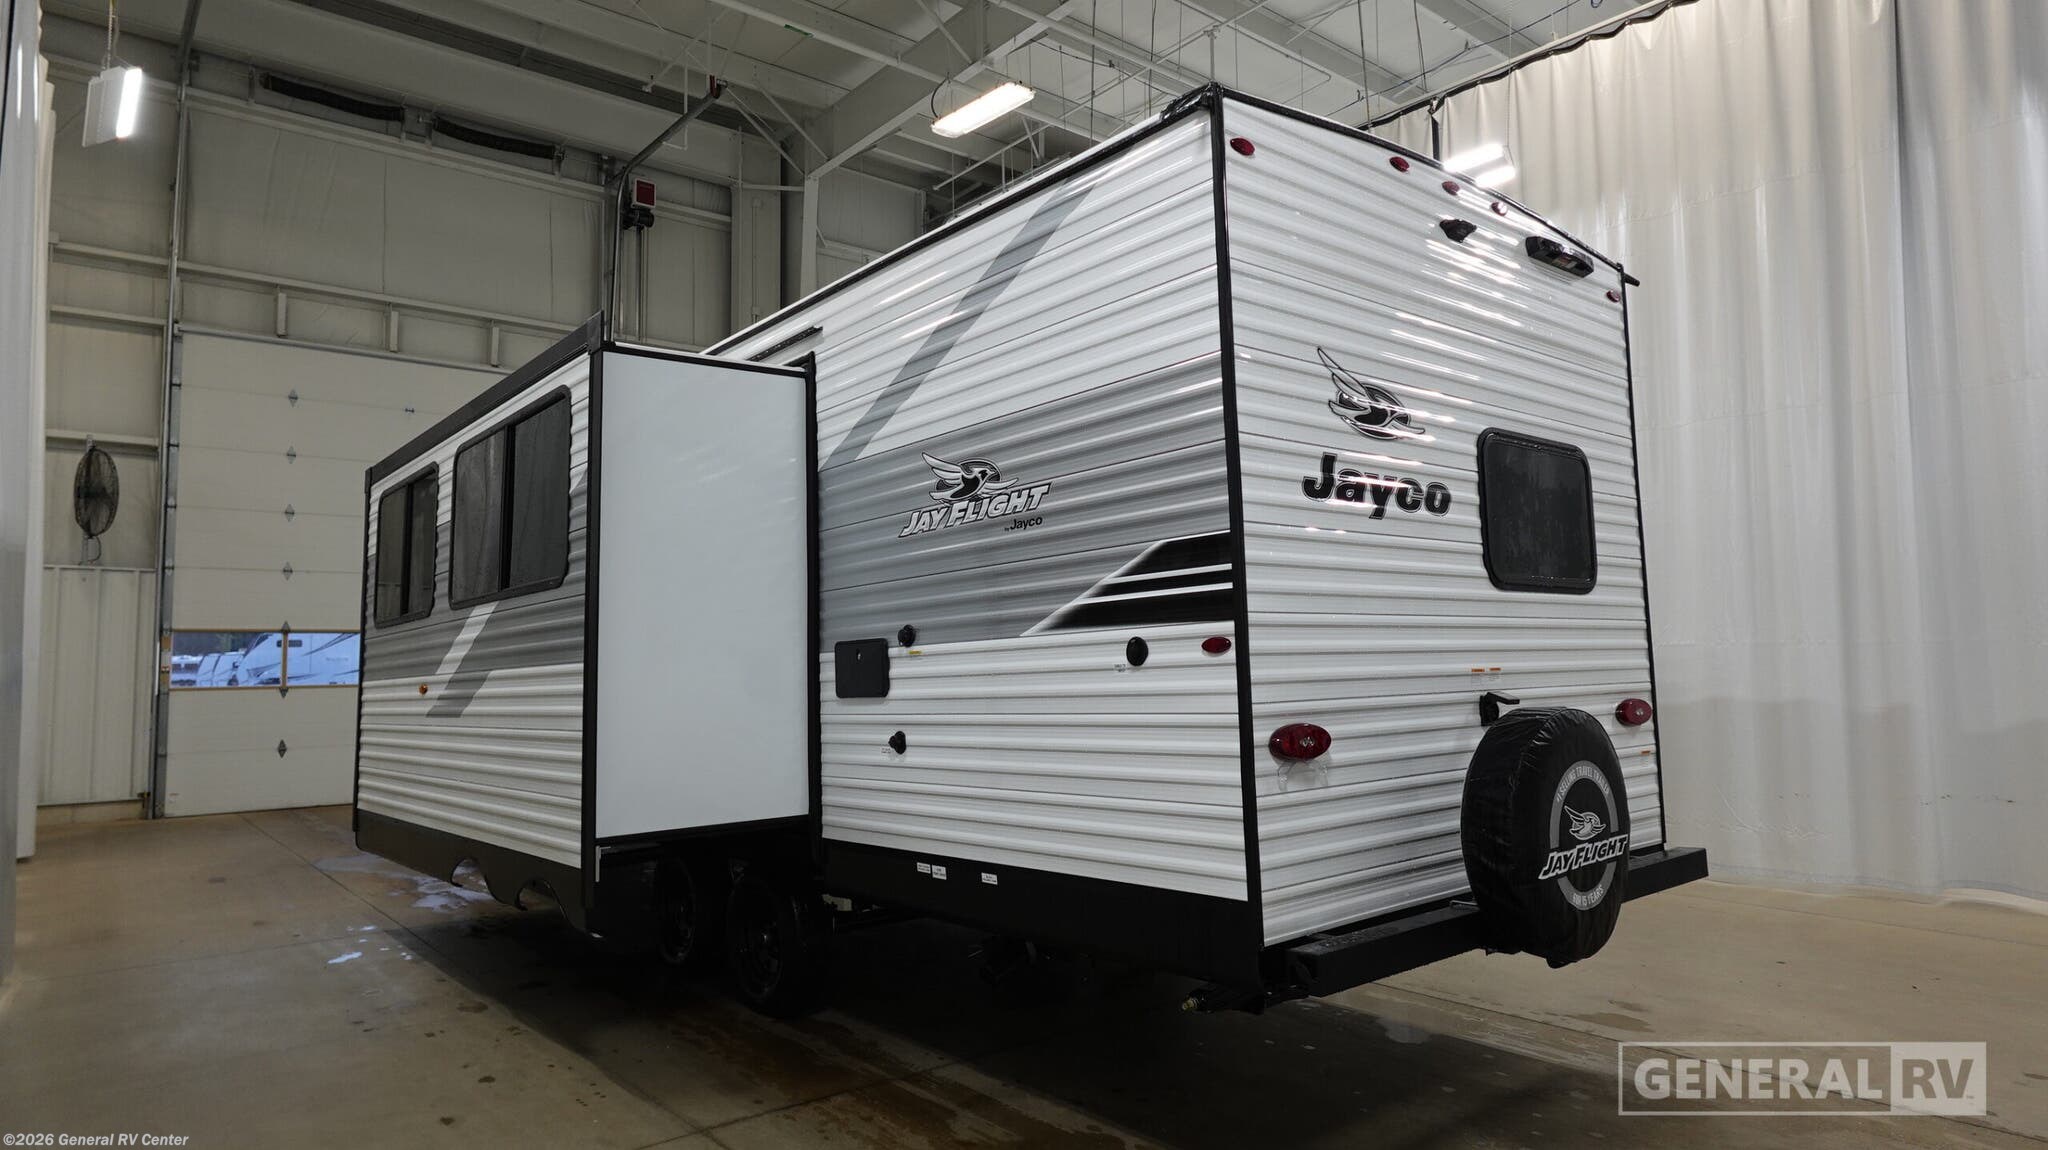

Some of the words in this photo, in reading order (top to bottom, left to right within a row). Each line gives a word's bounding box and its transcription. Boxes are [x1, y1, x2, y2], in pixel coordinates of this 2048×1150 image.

[898, 506, 949, 538] JAY
[946, 482, 1053, 527] FLIGHT
[1302, 452, 1451, 520] Jayco
[1010, 517, 1042, 530] Jayco
[1538, 850, 1574, 880] JAY
[1571, 834, 1629, 870] FLIGHT
